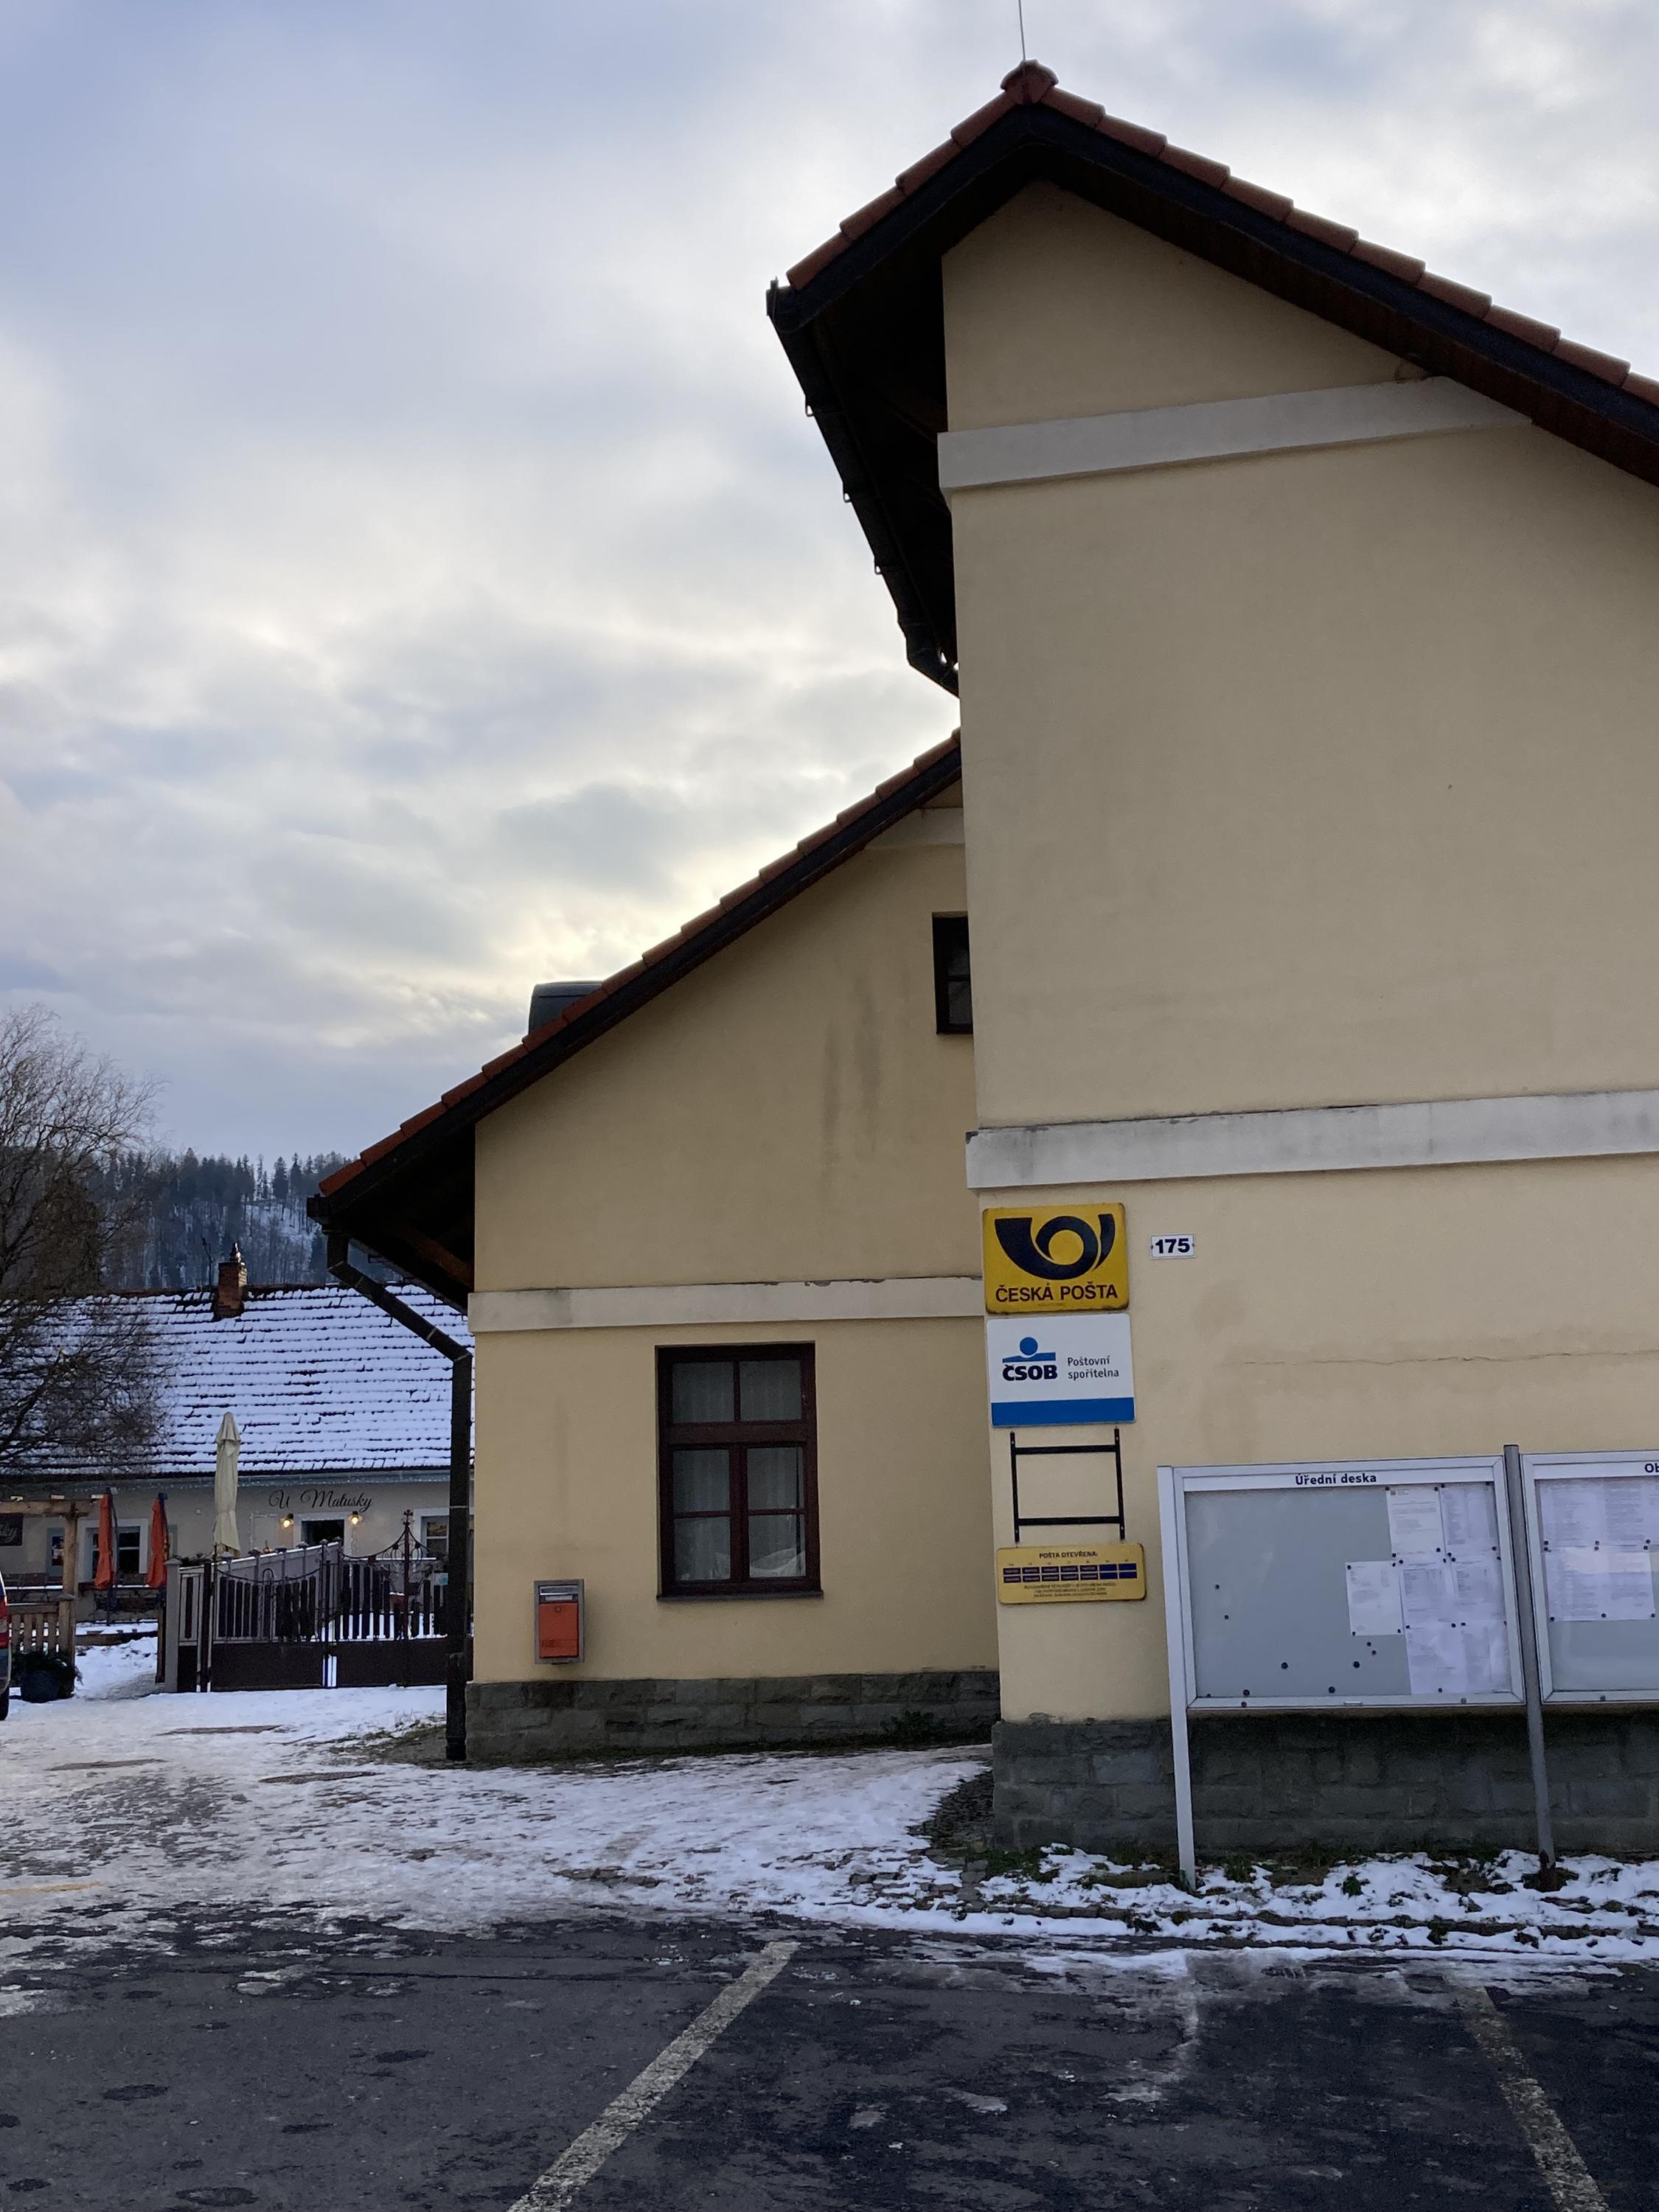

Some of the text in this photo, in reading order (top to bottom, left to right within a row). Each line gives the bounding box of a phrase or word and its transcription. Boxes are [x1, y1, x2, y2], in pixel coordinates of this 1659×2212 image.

[1155, 1238, 1190, 1254] 175
[995, 1281, 1118, 1302] ČESKÁ POŠTA
[1067, 1355, 1110, 1366] Poštovní
[1002, 1364, 1057, 1381] ČSOB
[1068, 1368, 1119, 1381] spořitelna
[1295, 1473, 1377, 1485] Úřední deska
[268, 1489, 290, 1509] U
